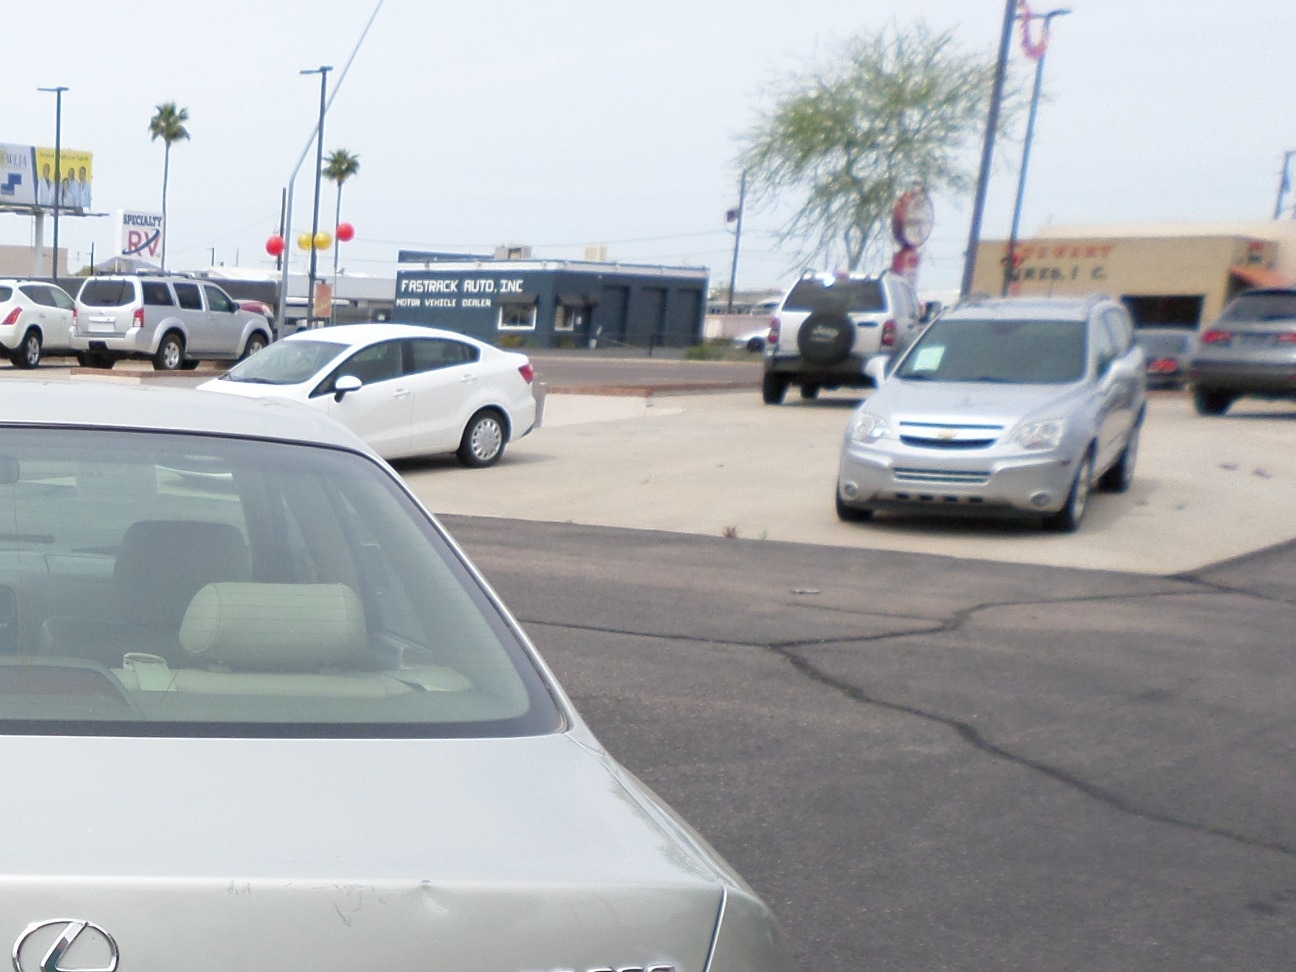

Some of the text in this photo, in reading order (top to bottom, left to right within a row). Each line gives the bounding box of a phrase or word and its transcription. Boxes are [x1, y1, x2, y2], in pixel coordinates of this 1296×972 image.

[123, 214, 162, 227] SPECIALTY
[128, 230, 160, 257] RV
[401, 280, 523, 293] FASTRACK AUTO, INC
[396, 299, 491, 307] MOTOR VEHICLE DEALER
